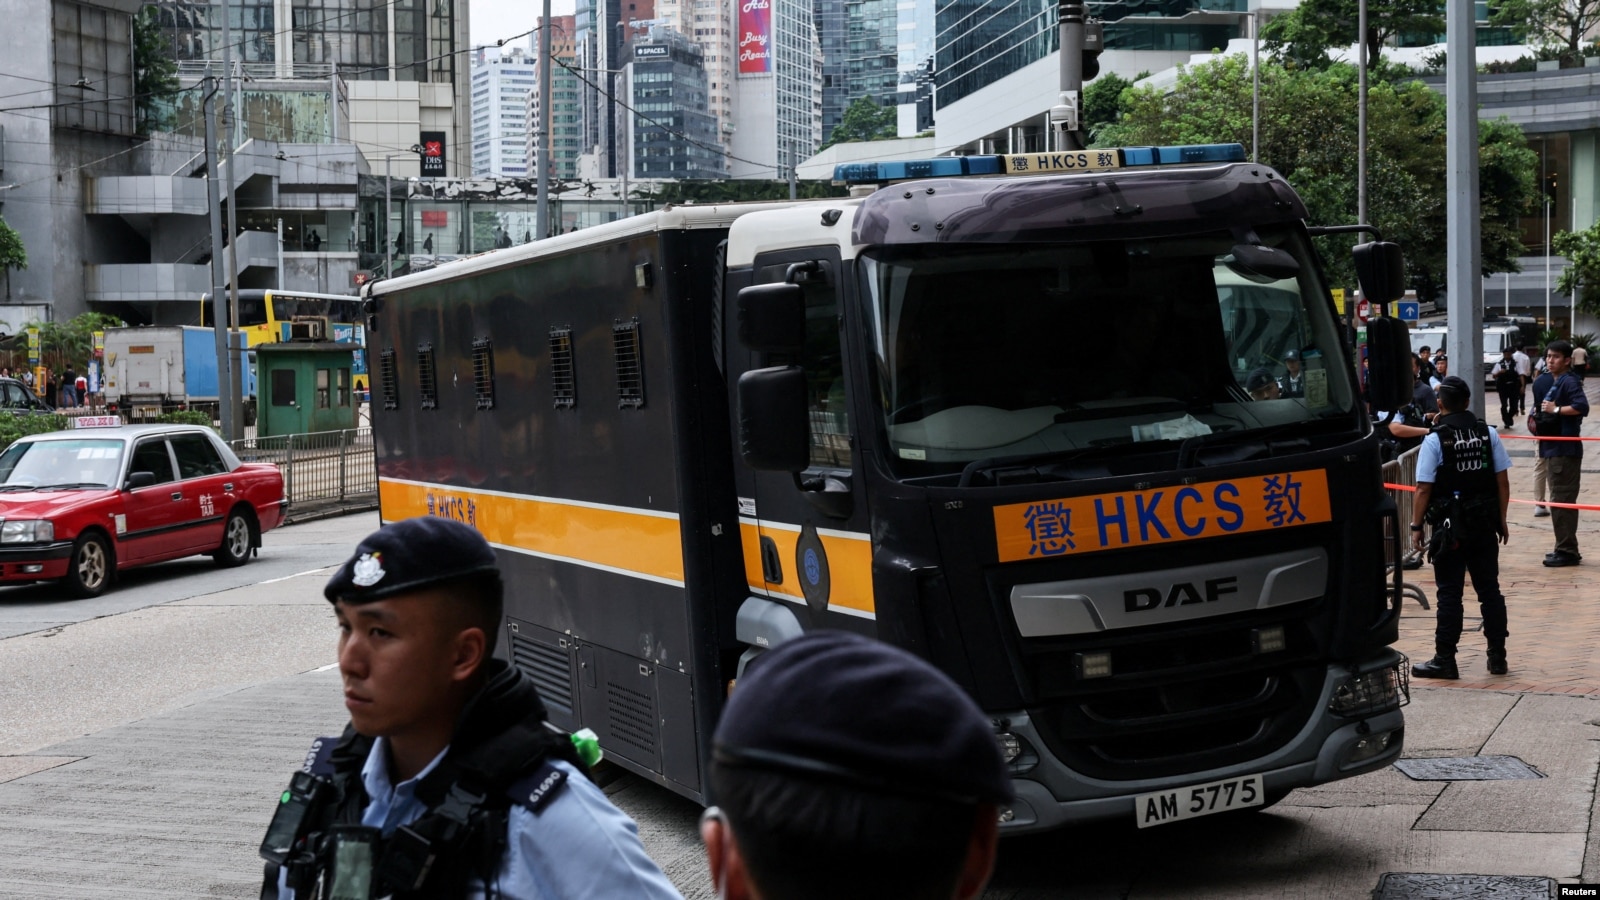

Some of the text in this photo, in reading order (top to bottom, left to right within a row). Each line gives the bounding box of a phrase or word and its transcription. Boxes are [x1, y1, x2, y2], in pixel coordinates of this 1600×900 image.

[743, 0, 769, 12] Ads
[740, 32, 767, 47] Busy
[740, 49, 770, 62] Reach
[1037, 153, 1088, 170] HKCS
[78, 416, 114, 427] TAXI
[1094, 482, 1244, 547] HKCS
[1123, 576, 1238, 613] DAF
[529, 771, 561, 803] 61690
[1145, 778, 1256, 823] AM 5775
